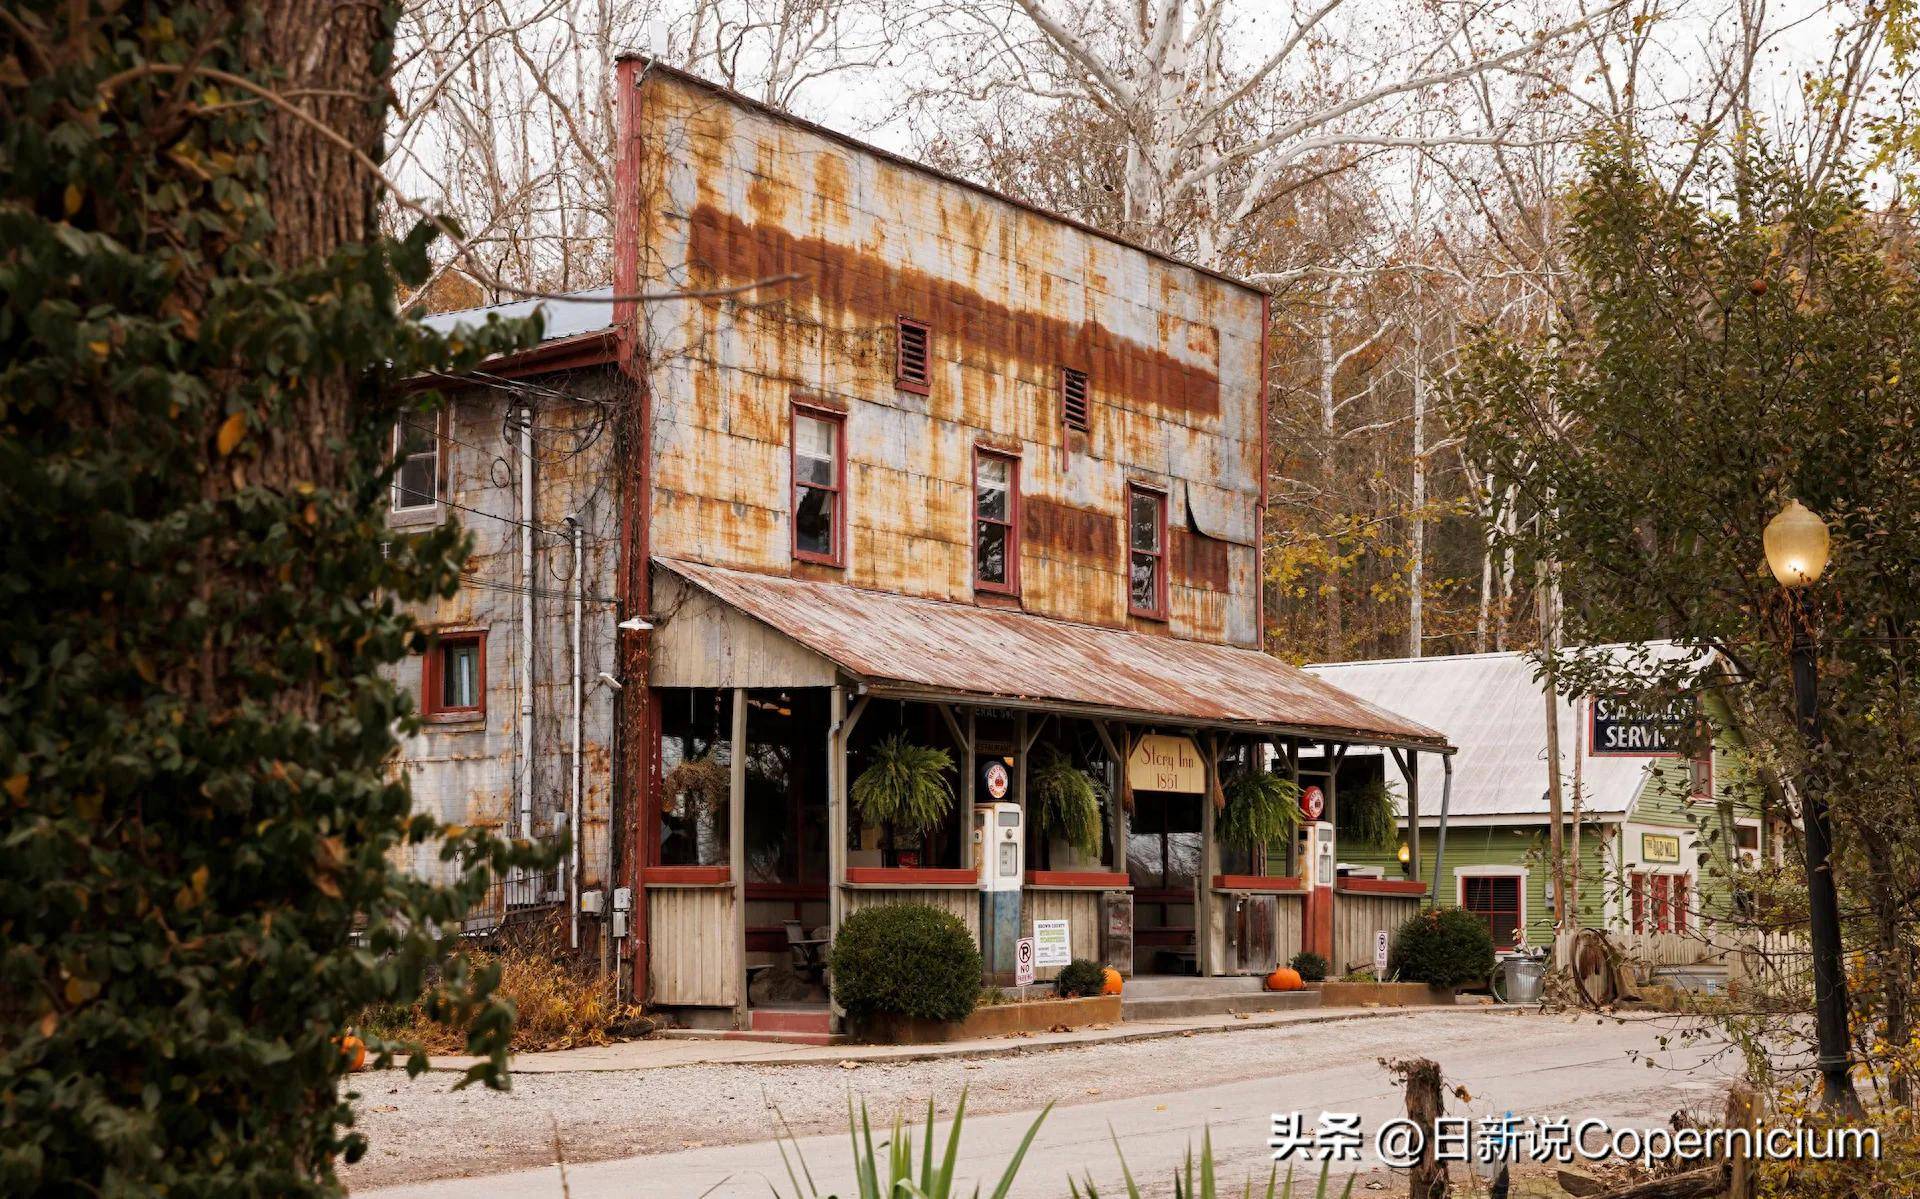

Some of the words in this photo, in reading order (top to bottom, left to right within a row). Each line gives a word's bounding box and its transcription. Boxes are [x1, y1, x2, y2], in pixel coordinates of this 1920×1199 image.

[1604, 725, 1681, 748] SERVIC
[1140, 740, 1174, 771] Story
[1178, 744, 1194, 769] Inn
[1156, 772, 1178, 790] 1851
[1020, 964, 1030, 973] NO
